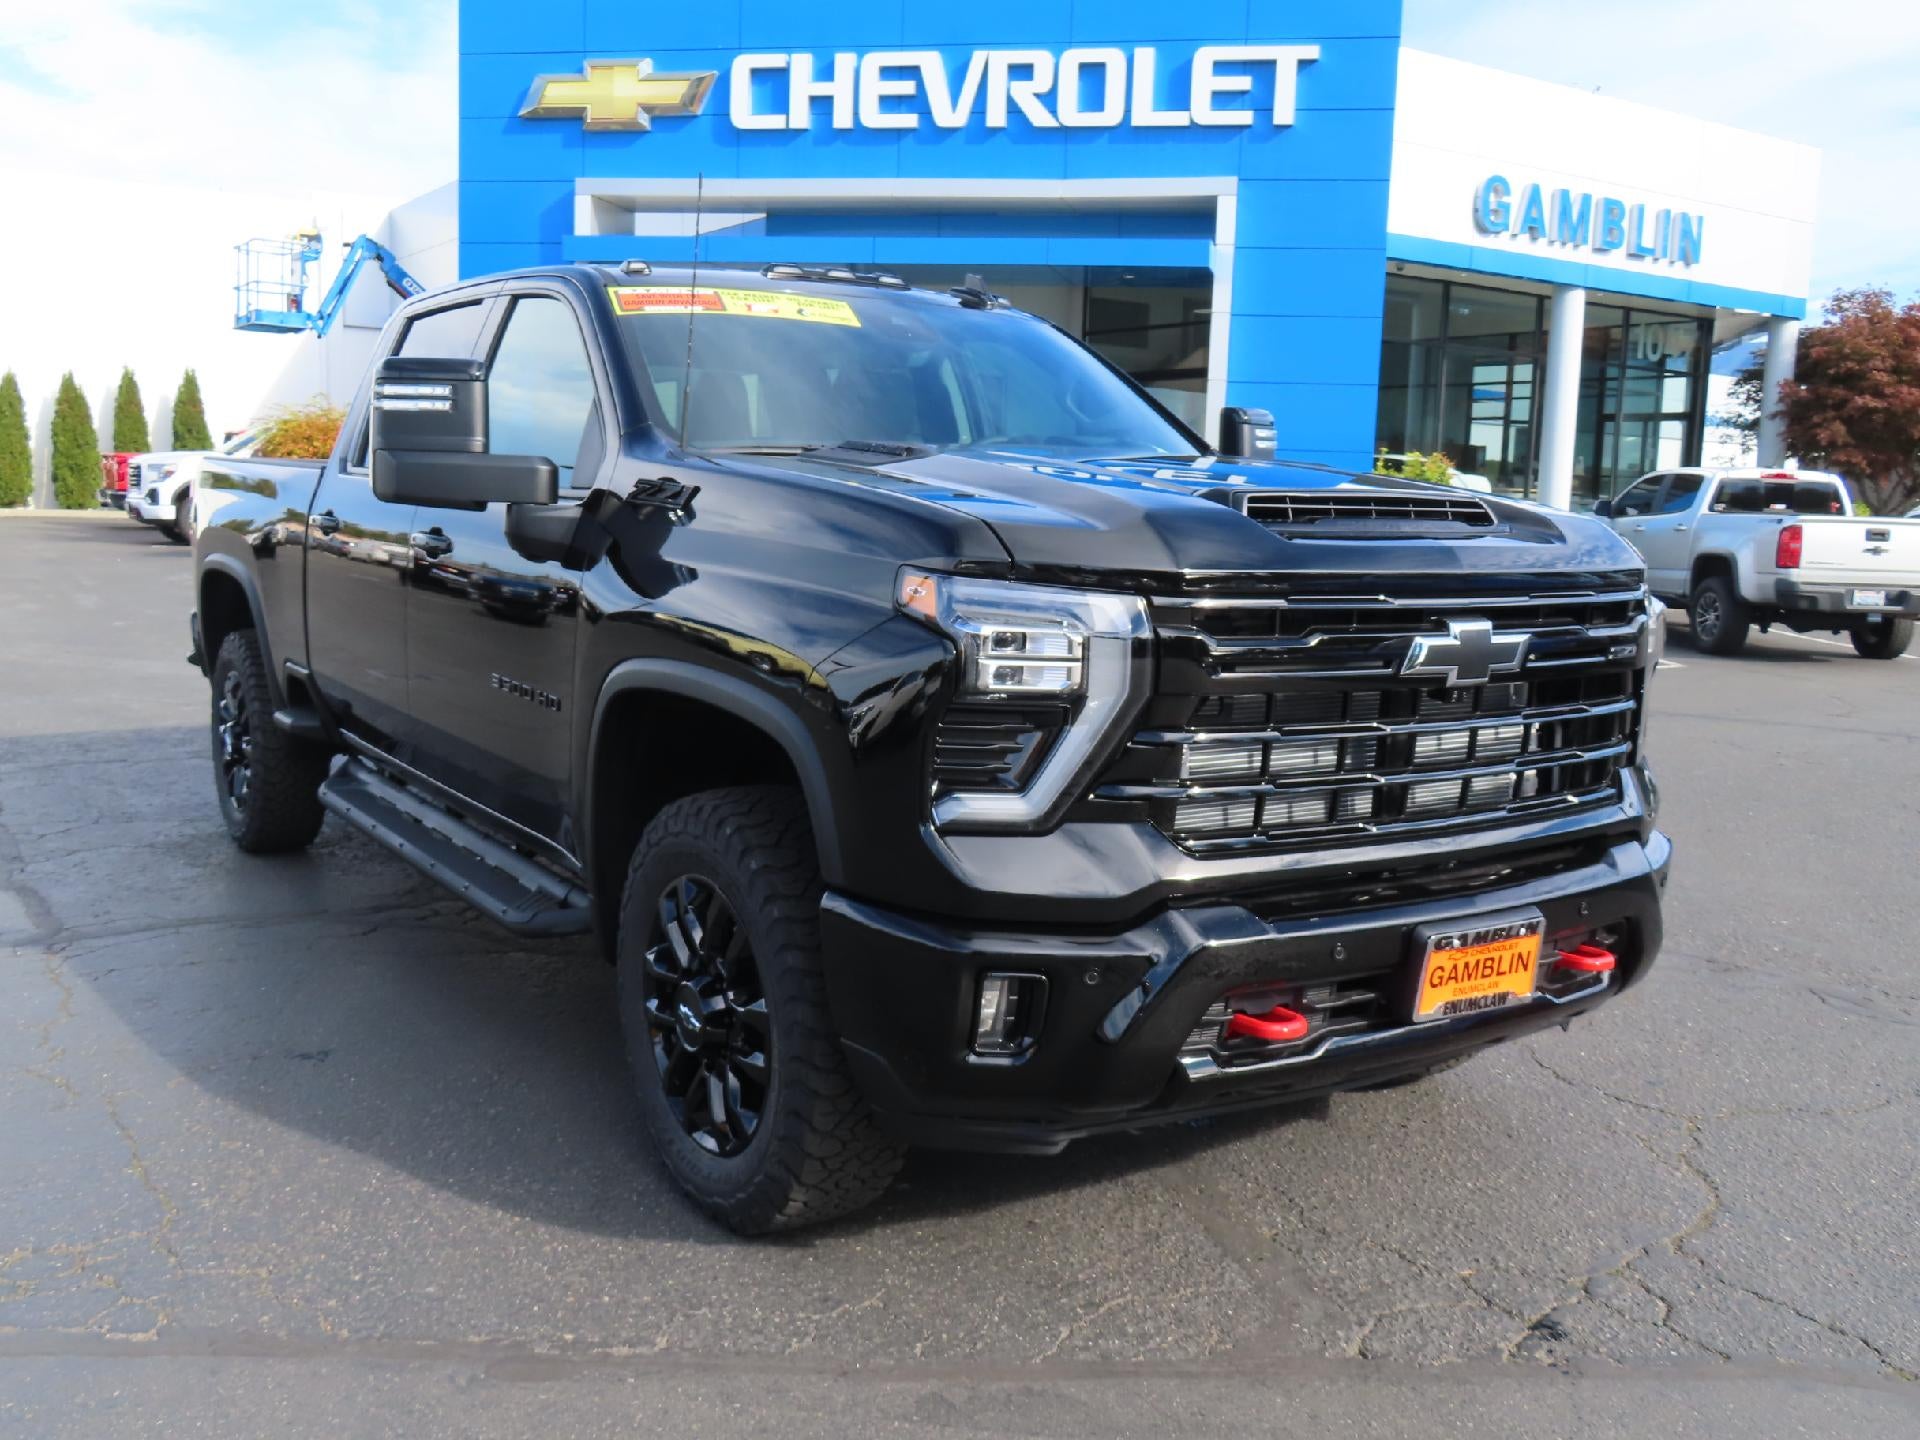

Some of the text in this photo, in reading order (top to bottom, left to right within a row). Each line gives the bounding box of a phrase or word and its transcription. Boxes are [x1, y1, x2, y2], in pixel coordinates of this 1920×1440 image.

[729, 45, 1320, 131] CHEVROLET
[1474, 174, 1704, 266] GAMBLIN
[1429, 951, 1532, 989] GAMBLIN
[1452, 980, 1500, 997] ENUMCLAW
